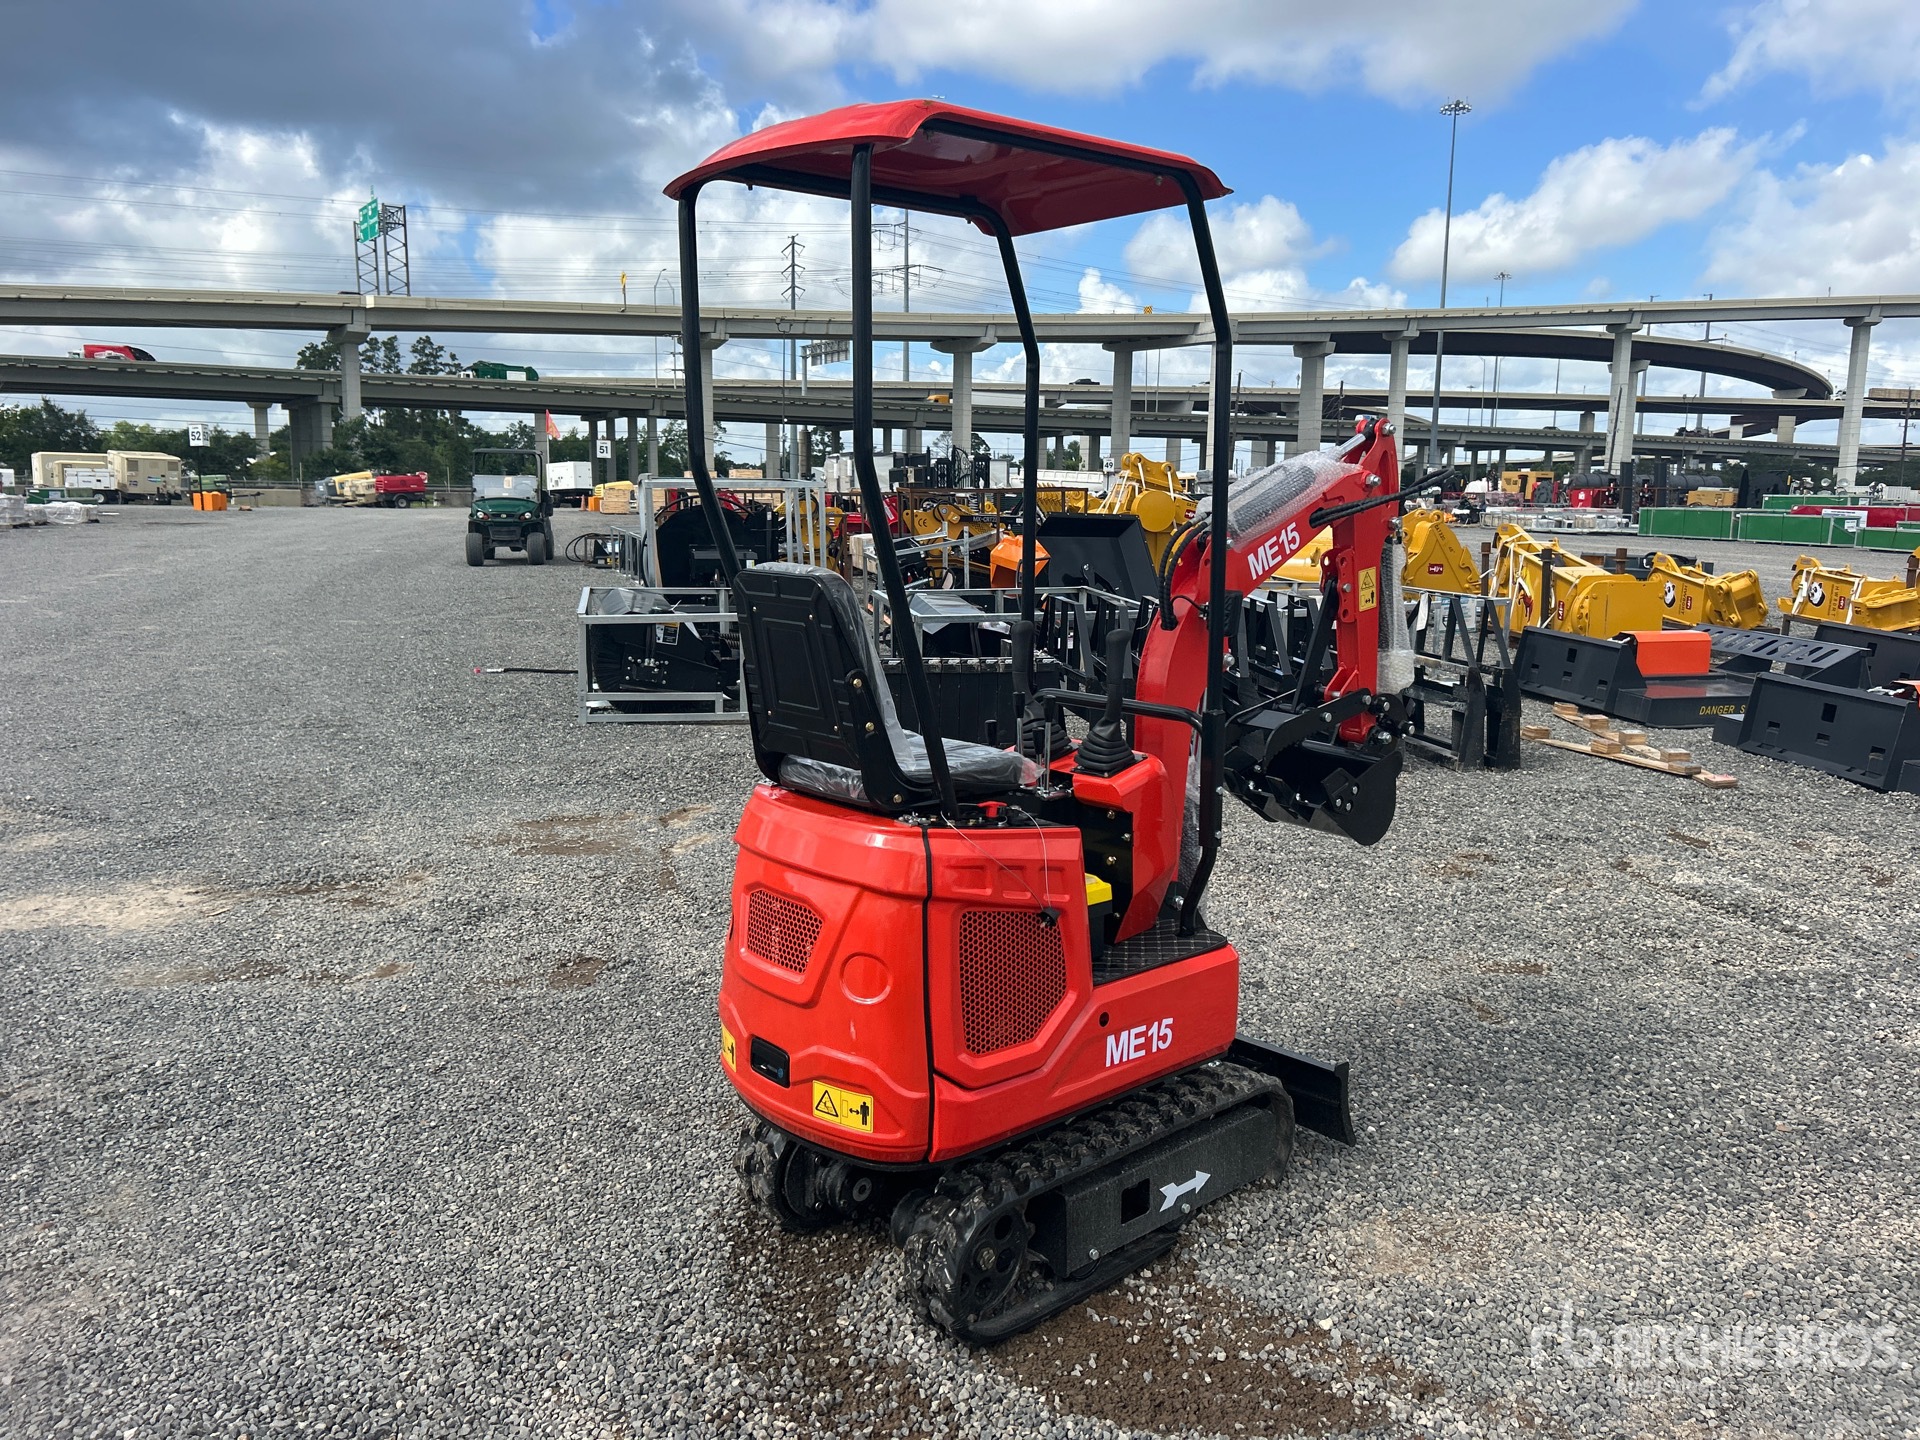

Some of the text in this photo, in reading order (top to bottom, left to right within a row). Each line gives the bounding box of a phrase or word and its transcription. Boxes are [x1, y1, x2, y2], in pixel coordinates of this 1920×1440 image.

[191, 430, 201, 441] 52
[599, 445, 608, 454] 51
[1104, 461, 1113, 469] 49
[1247, 521, 1300, 580] ME15
[1699, 705, 1735, 715] DANGER
[1105, 1017, 1174, 1068] ME15
